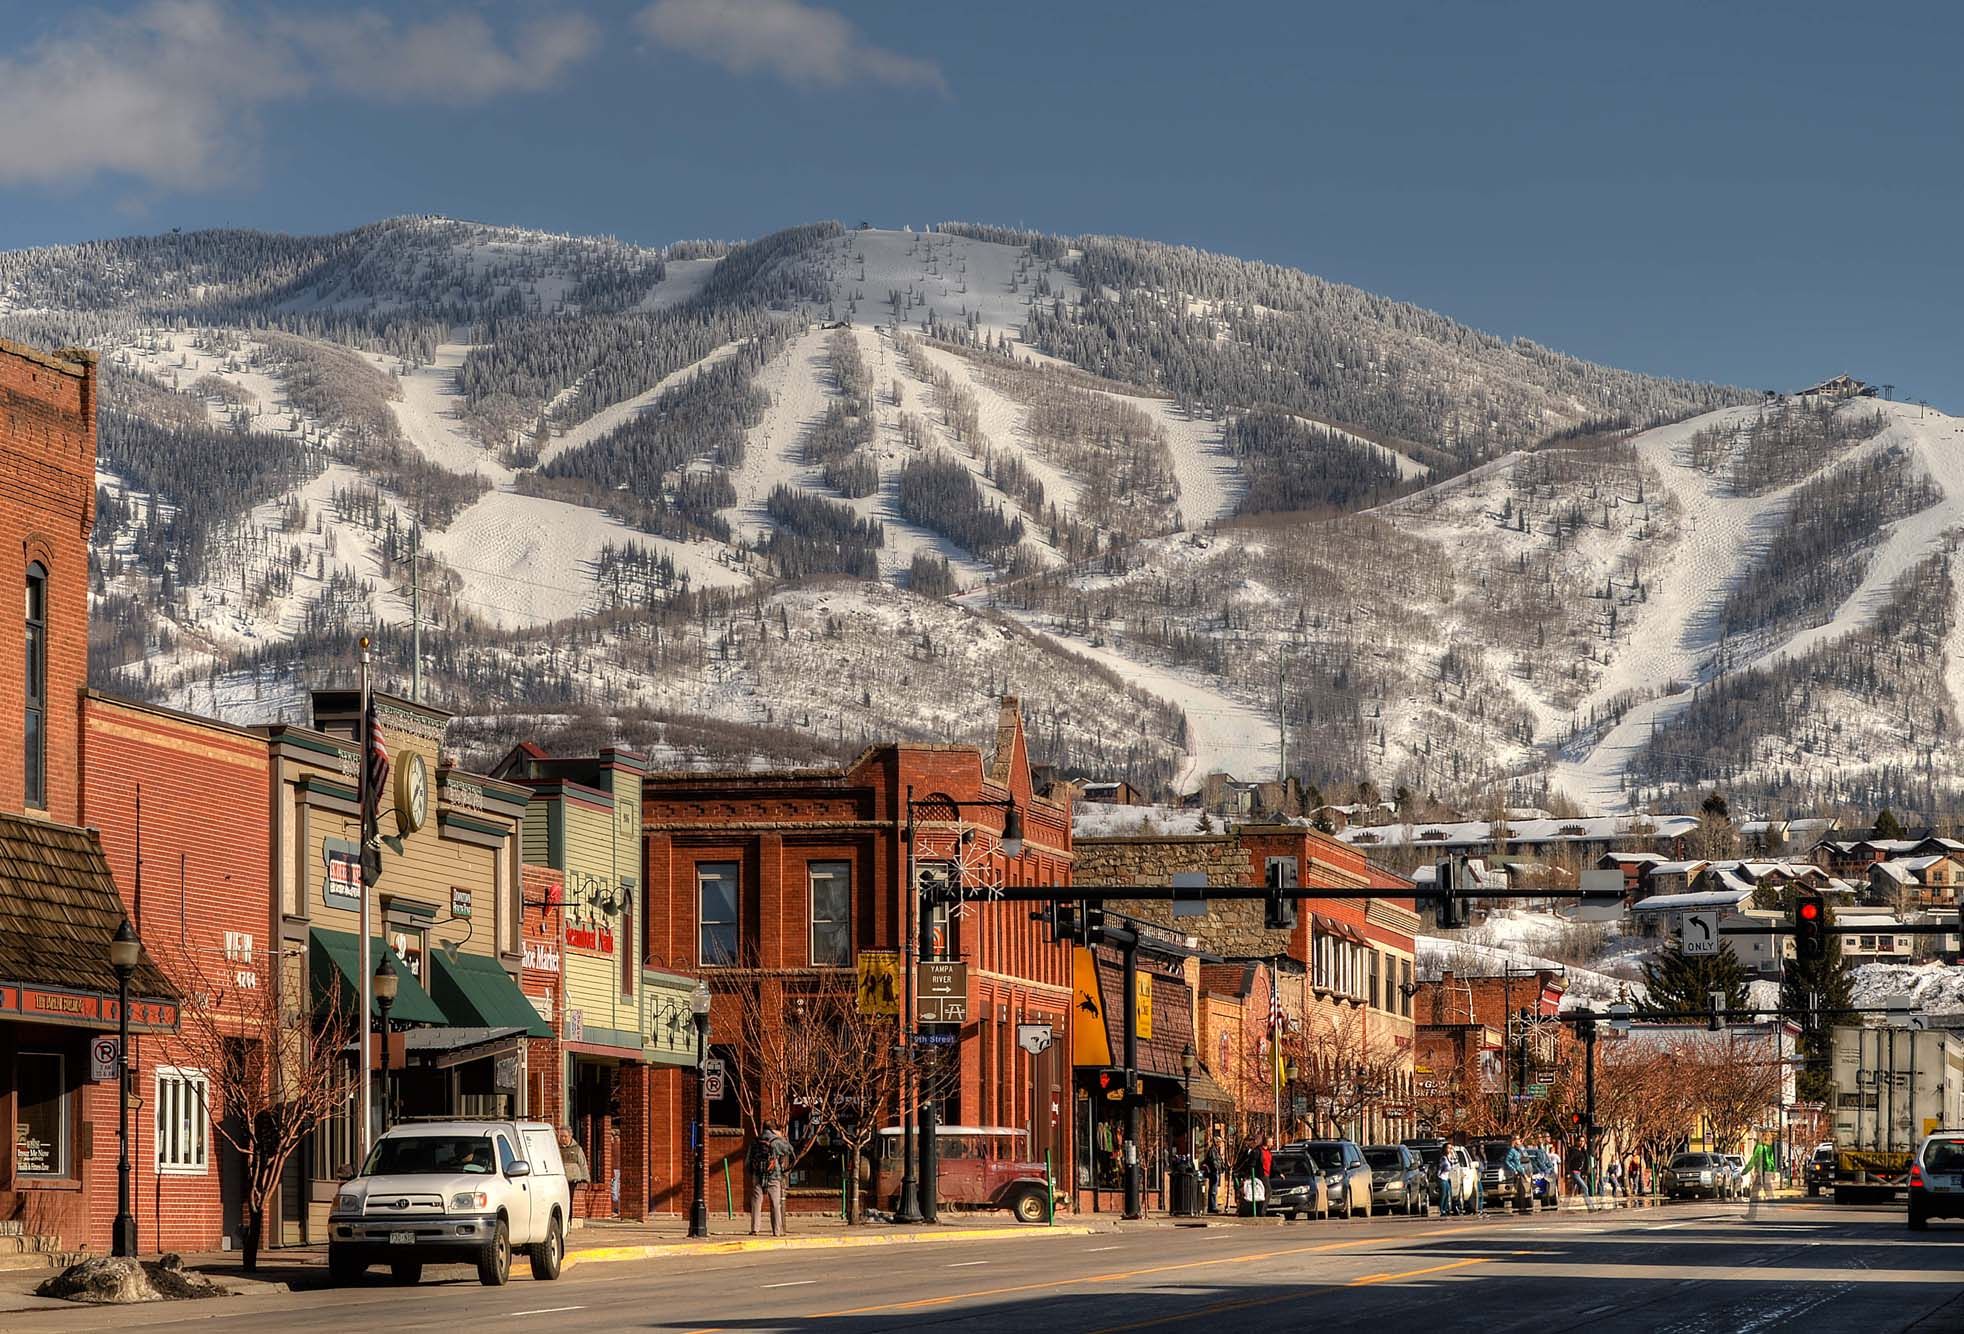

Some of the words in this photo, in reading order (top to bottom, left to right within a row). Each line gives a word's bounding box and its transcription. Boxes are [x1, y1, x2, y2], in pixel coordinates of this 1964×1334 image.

[223, 930, 252, 964] VFW
[1688, 942, 1714, 951] ONLY
[522, 941, 536, 967] hoe
[536, 944, 559, 971] Market
[931, 965, 953, 973] YAMPA
[932, 975, 952, 983] RIVER
[914, 1035, 927, 1044] 9th
[930, 1034, 954, 1044] Street
